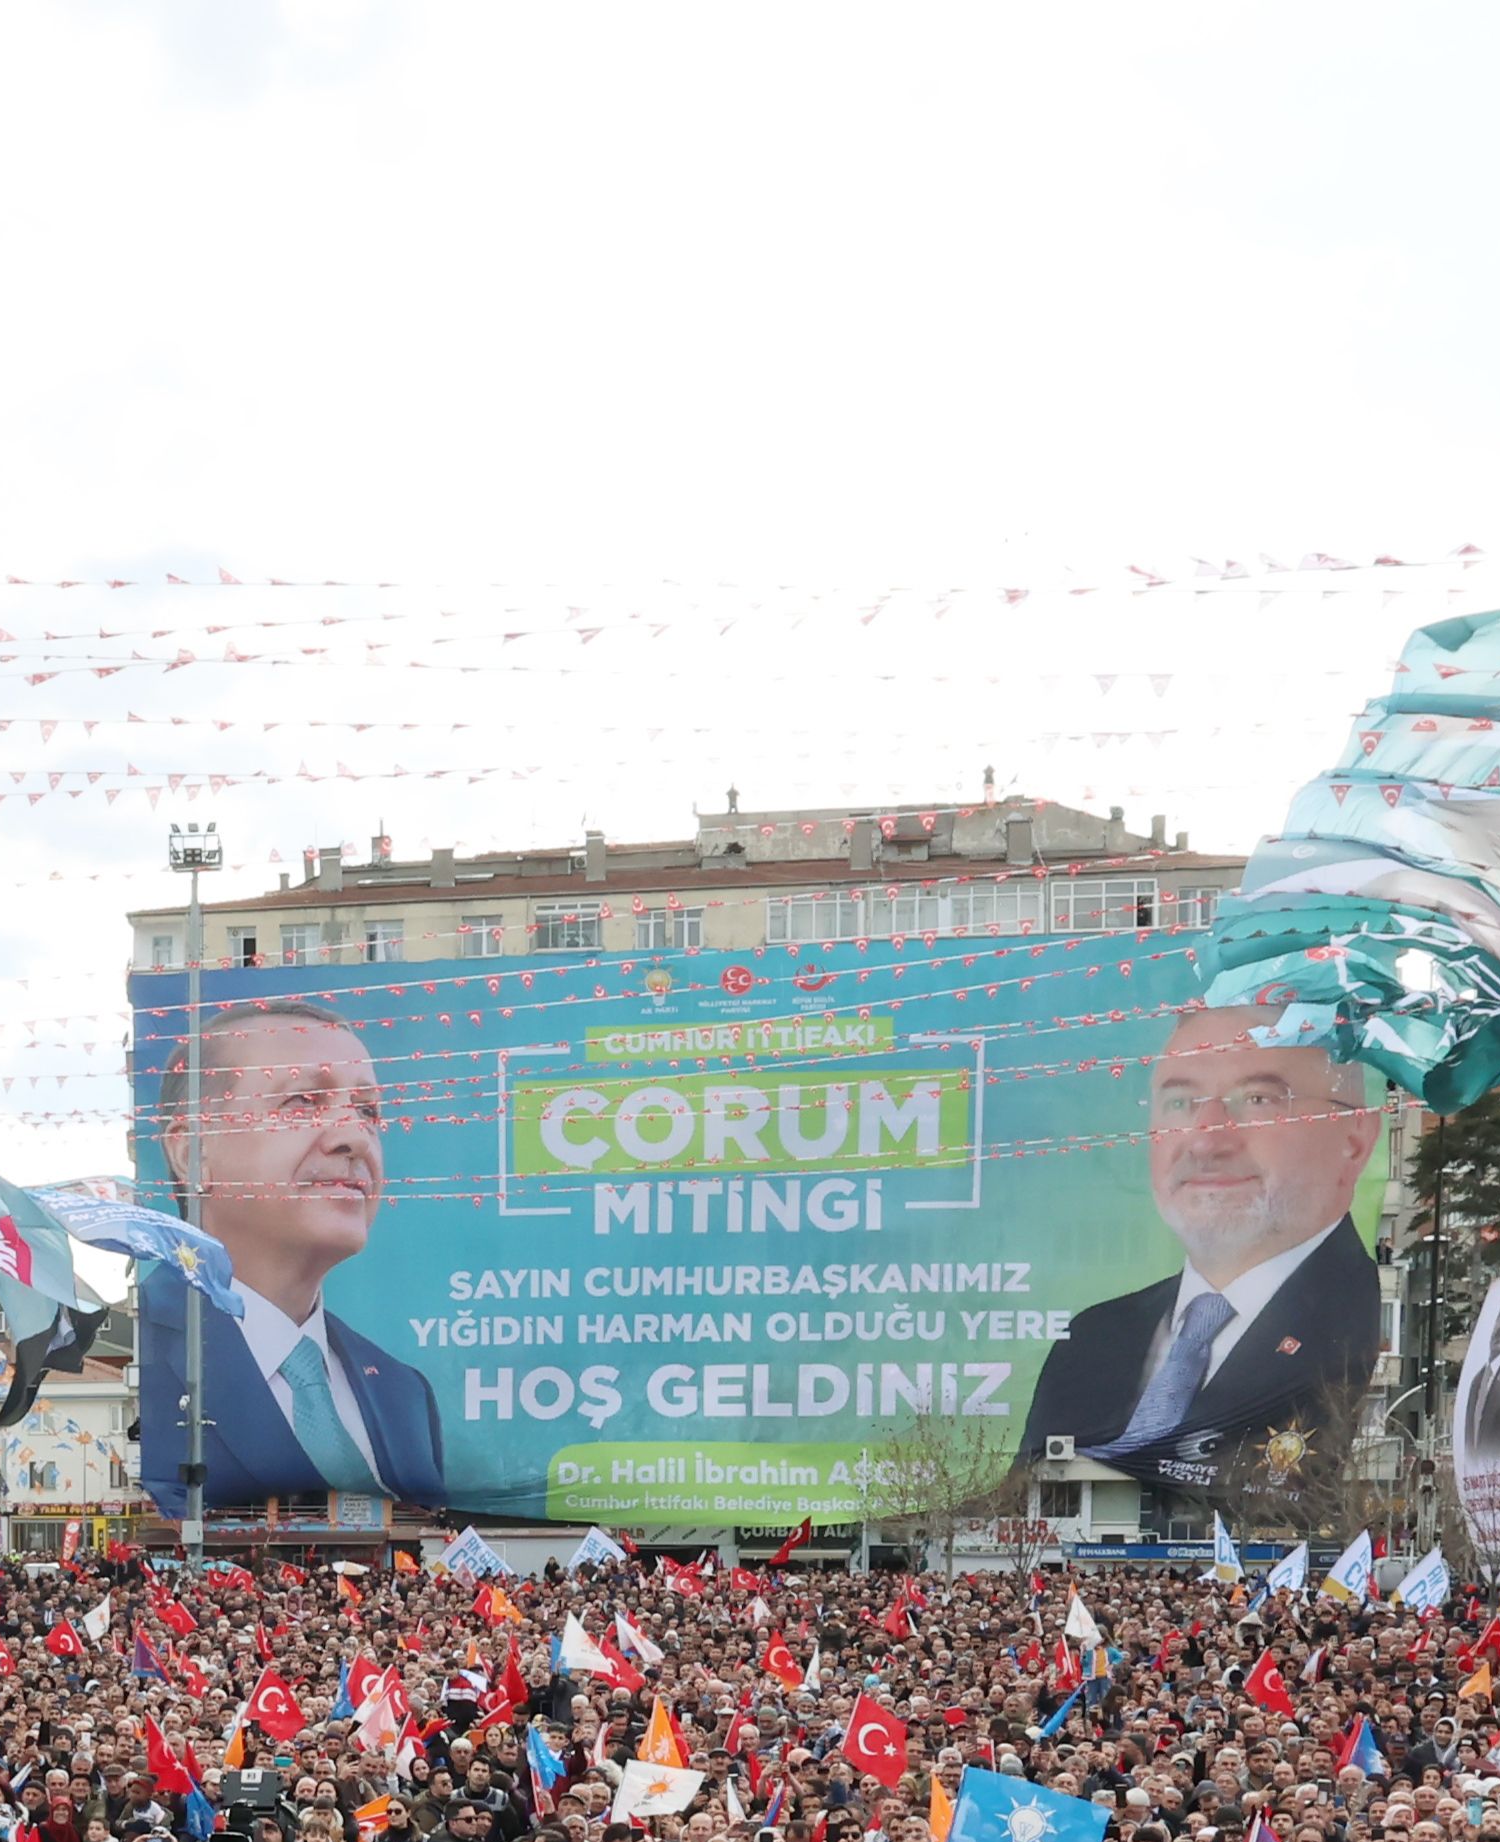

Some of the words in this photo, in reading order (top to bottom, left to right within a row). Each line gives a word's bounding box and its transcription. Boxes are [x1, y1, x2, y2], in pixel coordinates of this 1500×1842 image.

[604, 1030, 737, 1054] CUMHUR
[538, 1079, 942, 1171] ÇORUM
[593, 1178, 883, 1235] MİTİNGİ
[448, 1268, 572, 1301] SAYIN
[584, 1262, 1032, 1301] CUMHURBAŞKANIMIZ
[408, 1308, 565, 1348] YİĞİDİN
[577, 1312, 753, 1345] HARMAN
[765, 1302, 948, 1342] OLDUĞU
[961, 1309, 1072, 1341] YERE
[463, 1365, 625, 1430] HOŞ
[646, 1362, 1012, 1420] GELDİNİZ
[557, 1461, 602, 1485] Dr.
[610, 1457, 686, 1485] Halil
[694, 1452, 818, 1486] İbrahim
[564, 1494, 640, 1510] Cumhur
[713, 1495, 792, 1514] Belediye
